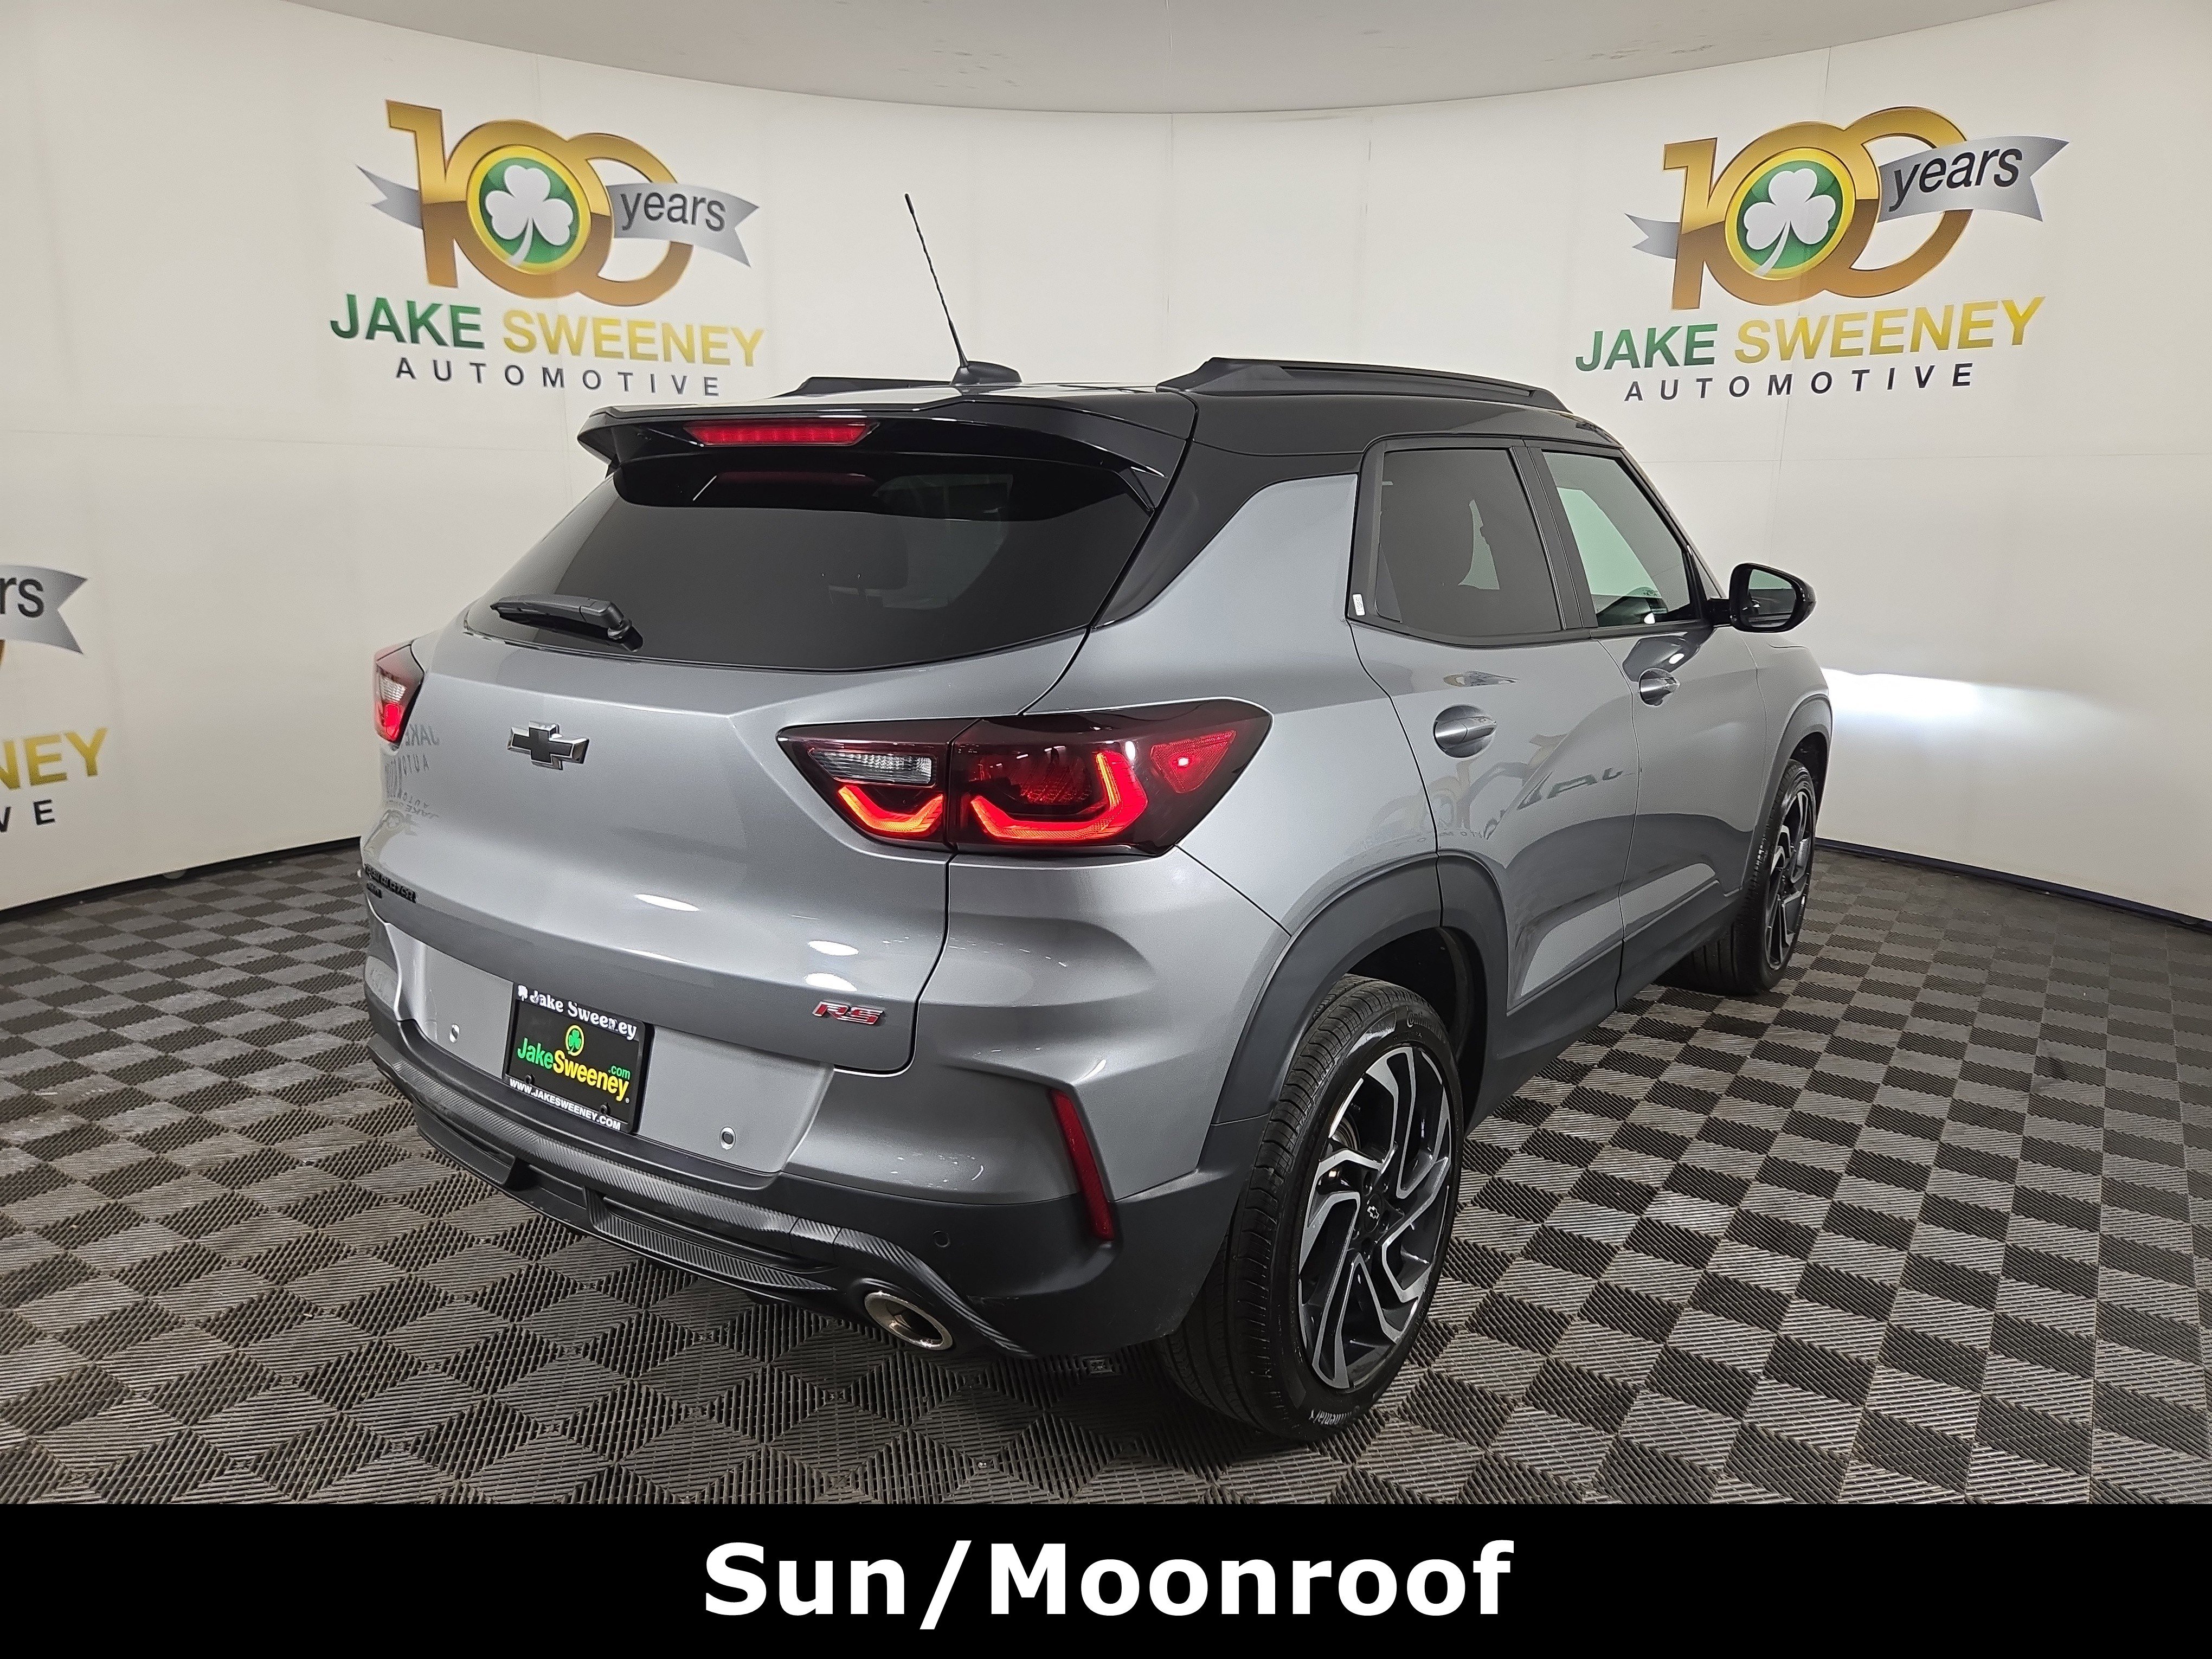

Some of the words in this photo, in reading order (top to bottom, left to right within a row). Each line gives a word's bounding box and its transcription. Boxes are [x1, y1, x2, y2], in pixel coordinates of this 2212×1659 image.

[1889, 147, 2023, 213] years
[620, 191, 726, 232] years
[330, 293, 485, 350] JAKE
[503, 309, 765, 368] SWEENEY
[1576, 324, 1718, 373] JAKE
[1735, 296, 2046, 364] SWEENEY
[396, 357, 720, 397] AUTOMOTIVE
[1624, 363, 1974, 402] AUTOMOTIVE
[530, 990, 564, 1013] Jake
[568, 1001, 637, 1040] Sweeney
[812, 1000, 884, 1025] RS
[509, 1078, 621, 1131] WWW.JAKESWEENEY.COM
